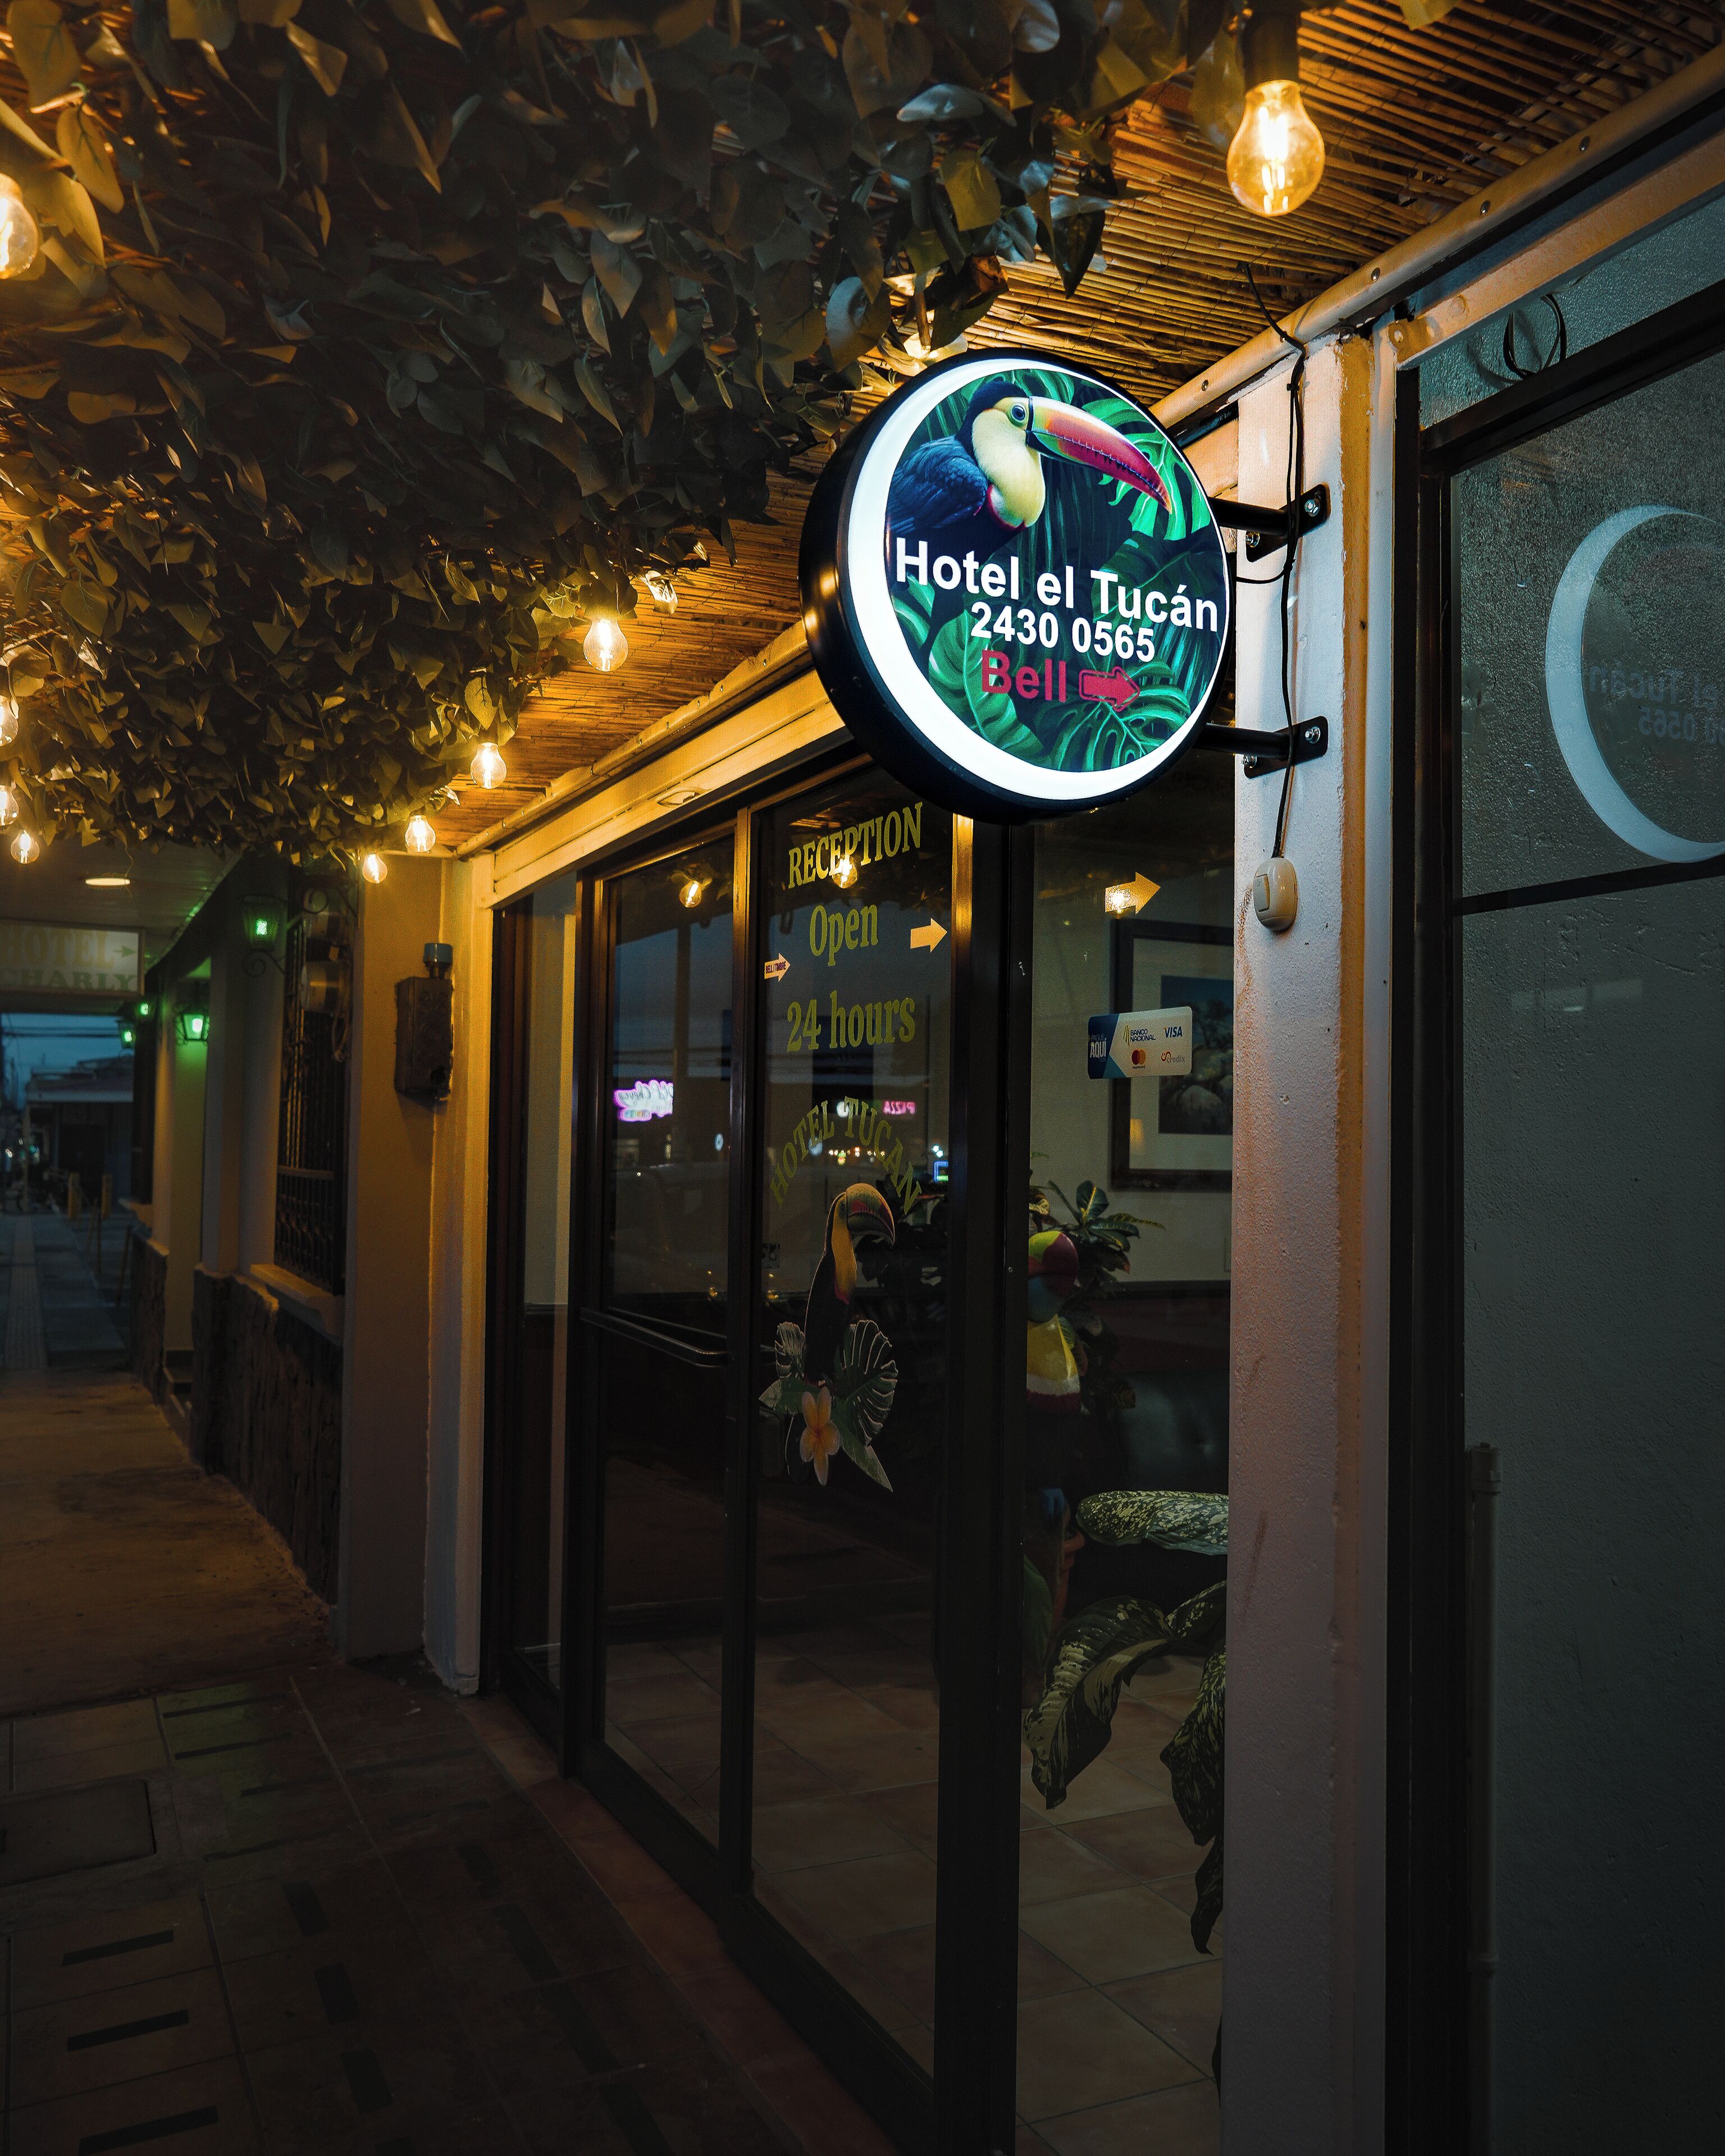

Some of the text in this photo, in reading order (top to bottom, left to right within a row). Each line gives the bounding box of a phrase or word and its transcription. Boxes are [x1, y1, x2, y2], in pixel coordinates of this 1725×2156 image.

[896, 537, 1217, 632] Hotel el Tucán
[971, 602, 1156, 663] 2430 0565
[982, 651, 1066, 702] Bell
[788, 802, 923, 889] RECEPTION
[0, 925, 114, 969] HOTEL
[809, 904, 879, 967] Open
[0, 969, 136, 991] CHARLY
[787, 990, 916, 1052] 24 hours
[1090, 1038, 1107, 1058] AQUÍ
[1163, 1026, 1183, 1038] VISA
[769, 1096, 922, 1216] HOTEL TUCAN
